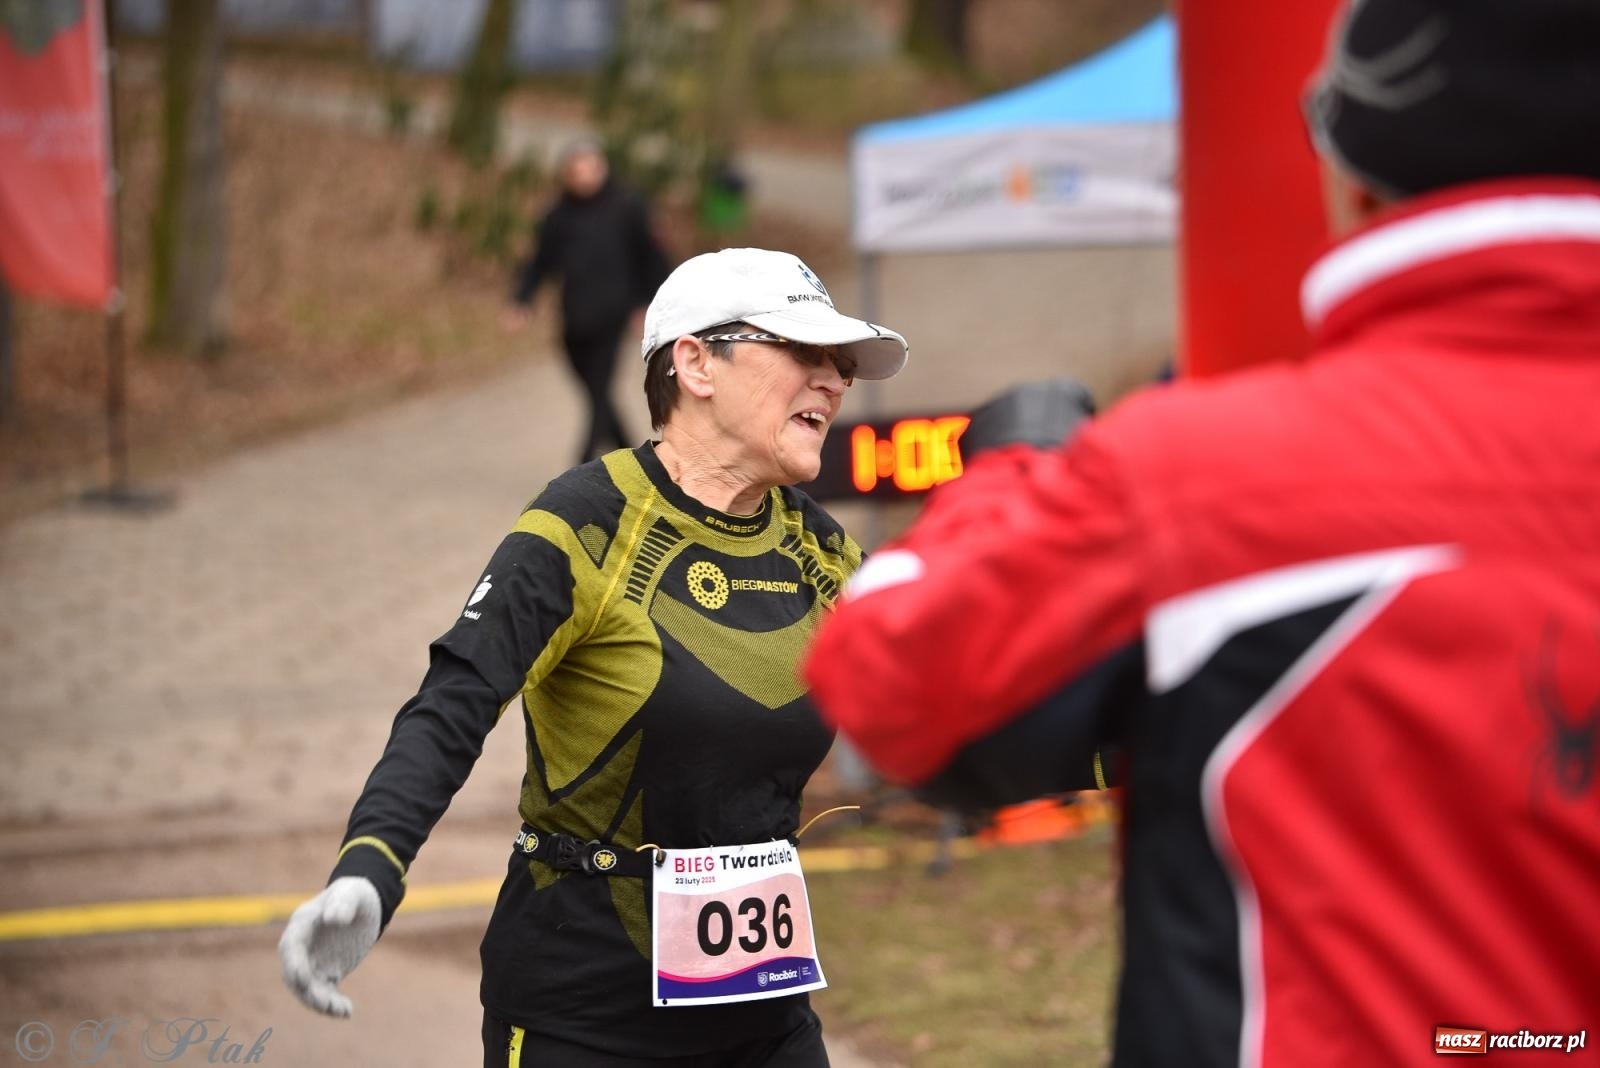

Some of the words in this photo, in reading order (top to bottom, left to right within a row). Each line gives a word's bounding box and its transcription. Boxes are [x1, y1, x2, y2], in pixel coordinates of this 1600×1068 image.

[705, 515, 760, 534] BRUBECK
[674, 856, 715, 873] BIEG
[719, 849, 793, 871] Twardziela
[685, 877, 701, 887] luty
[697, 893, 794, 957] 036
